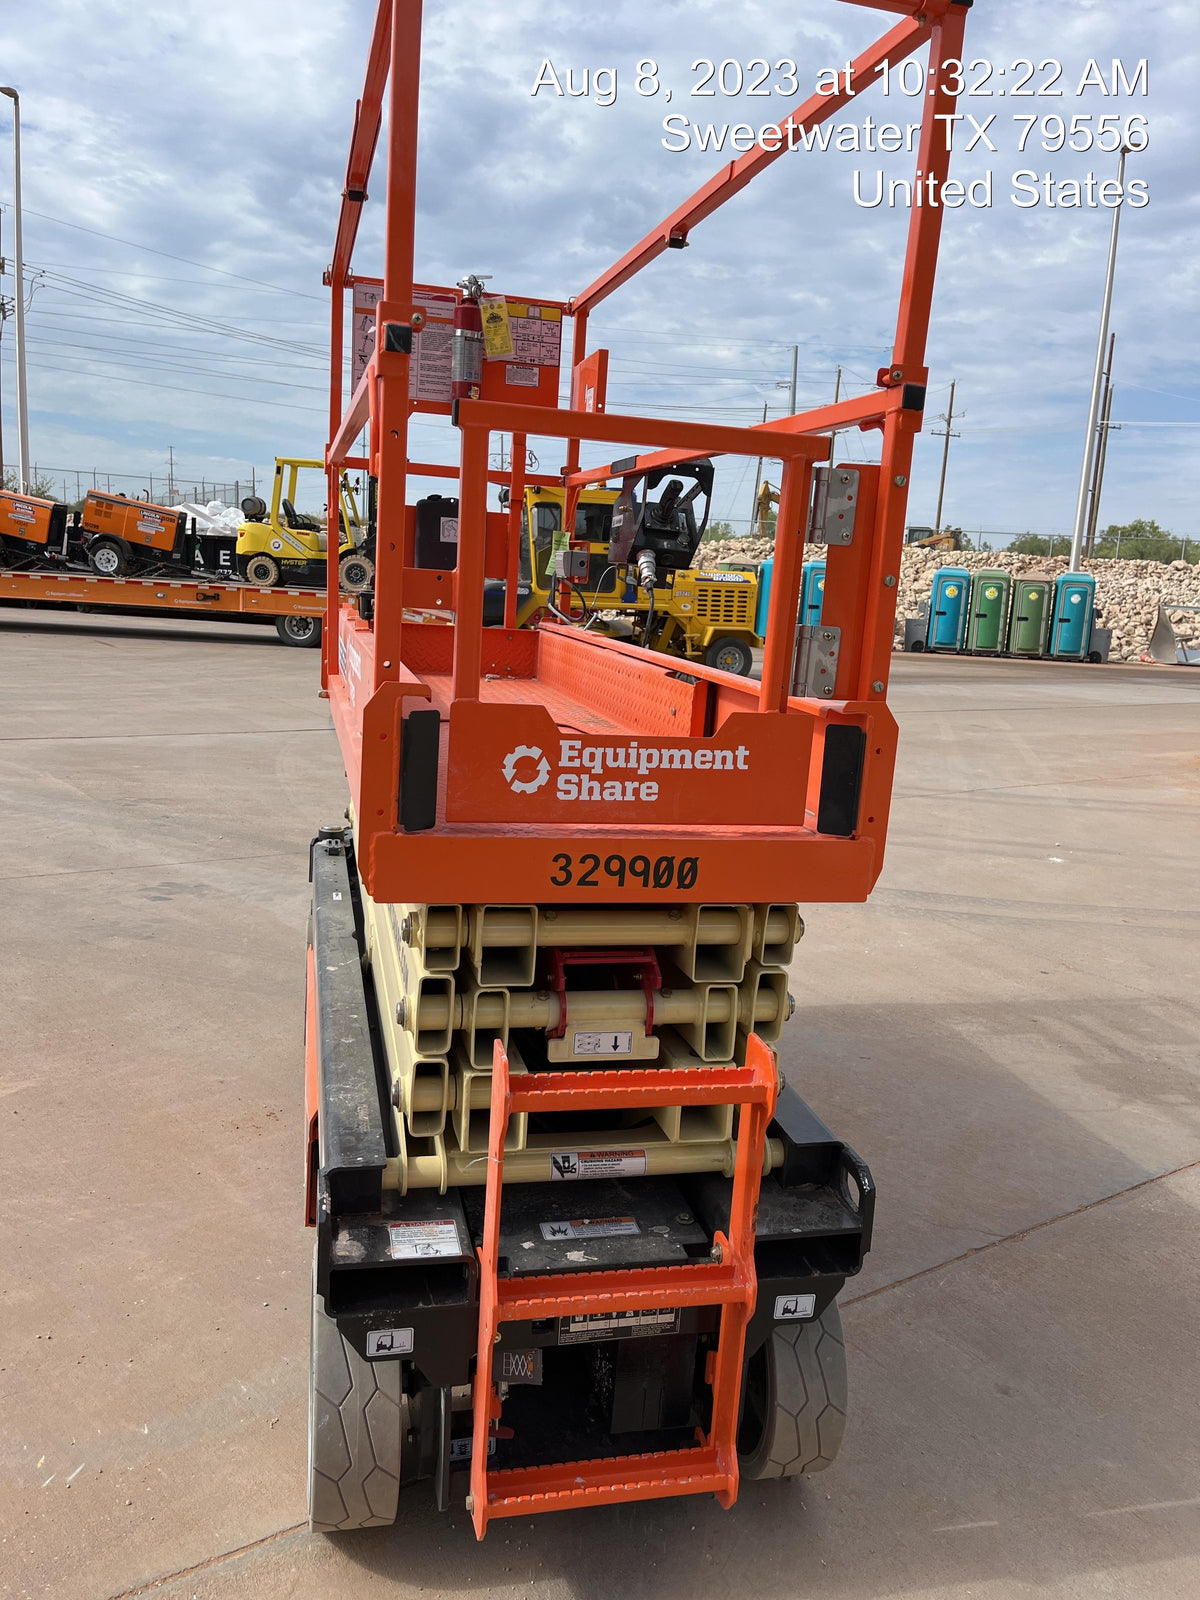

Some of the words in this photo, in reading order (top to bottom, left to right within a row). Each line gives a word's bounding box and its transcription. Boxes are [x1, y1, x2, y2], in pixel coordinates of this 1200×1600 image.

[140, 510, 161, 519] LINCOLN
[281, 559, 308, 567] HYSTER
[557, 739, 750, 775] Equipment
[556, 773, 659, 802] Share
[549, 852, 701, 890] 329900
[597, 1151, 635, 1159] WARNING
